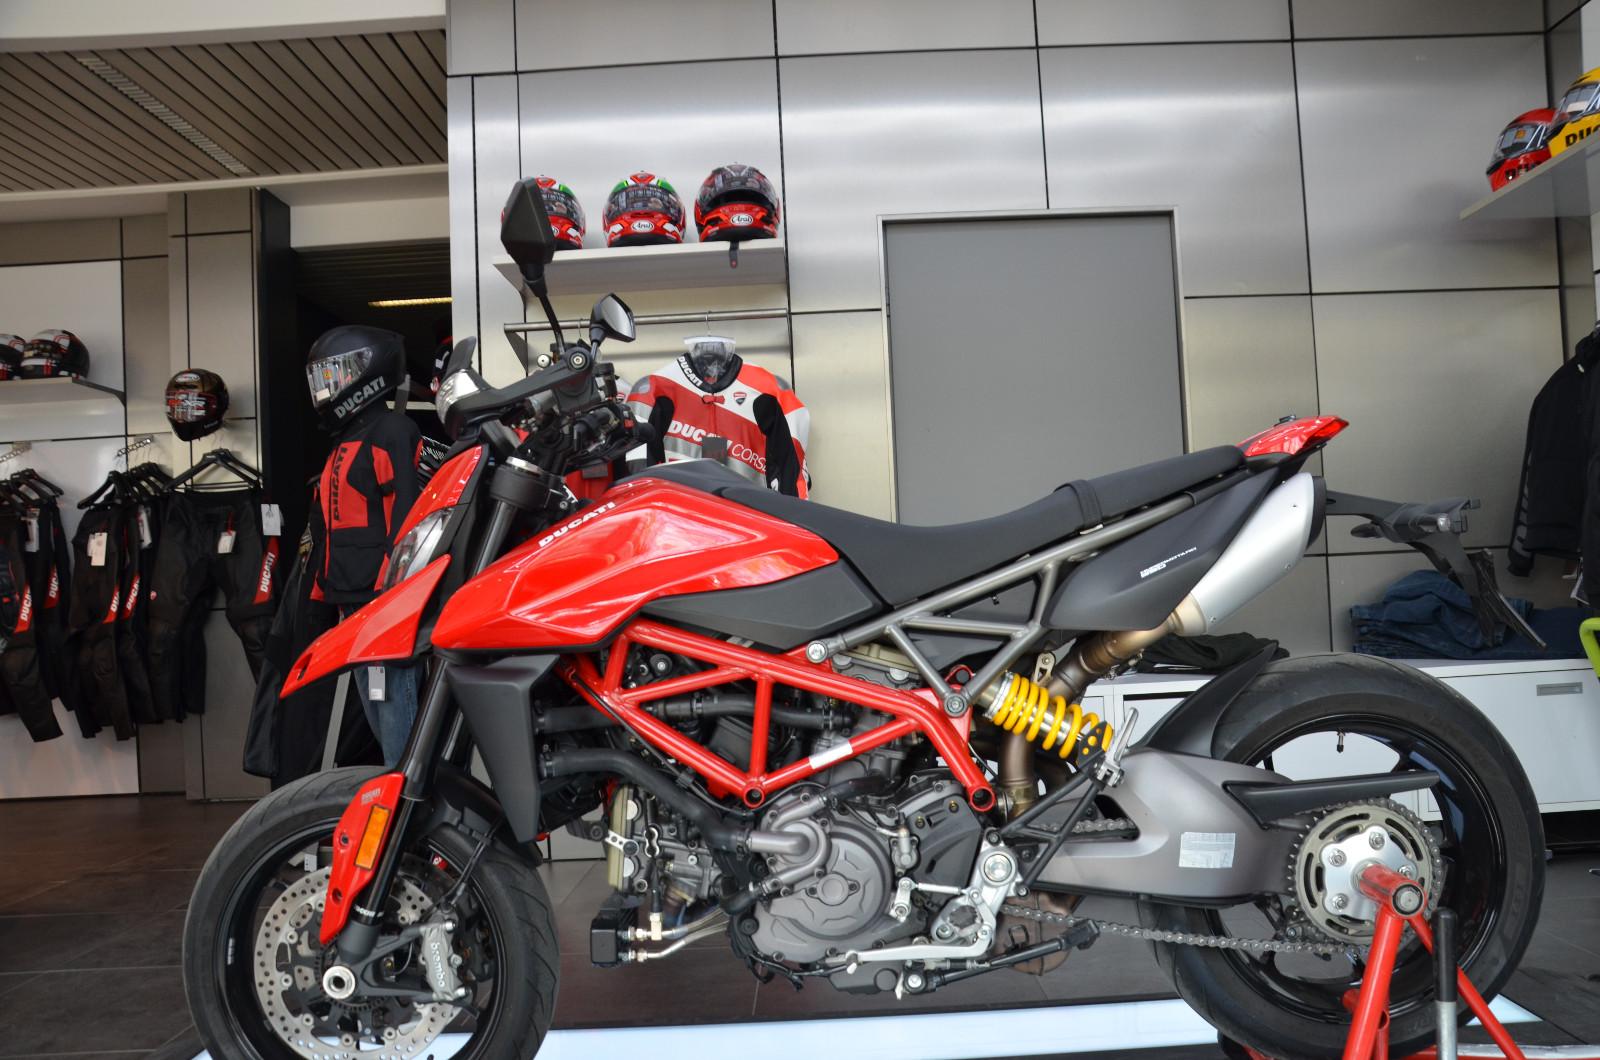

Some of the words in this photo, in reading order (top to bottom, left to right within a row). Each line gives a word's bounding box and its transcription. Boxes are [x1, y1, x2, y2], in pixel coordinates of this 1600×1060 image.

[678, 356, 703, 386] DUCATI
[334, 376, 386, 419] DUCATI
[731, 444, 767, 472] CORS
[538, 501, 616, 547] DUCATI
[260, 552, 275, 592] DUCATI
[430, 942, 445, 987] brembo
